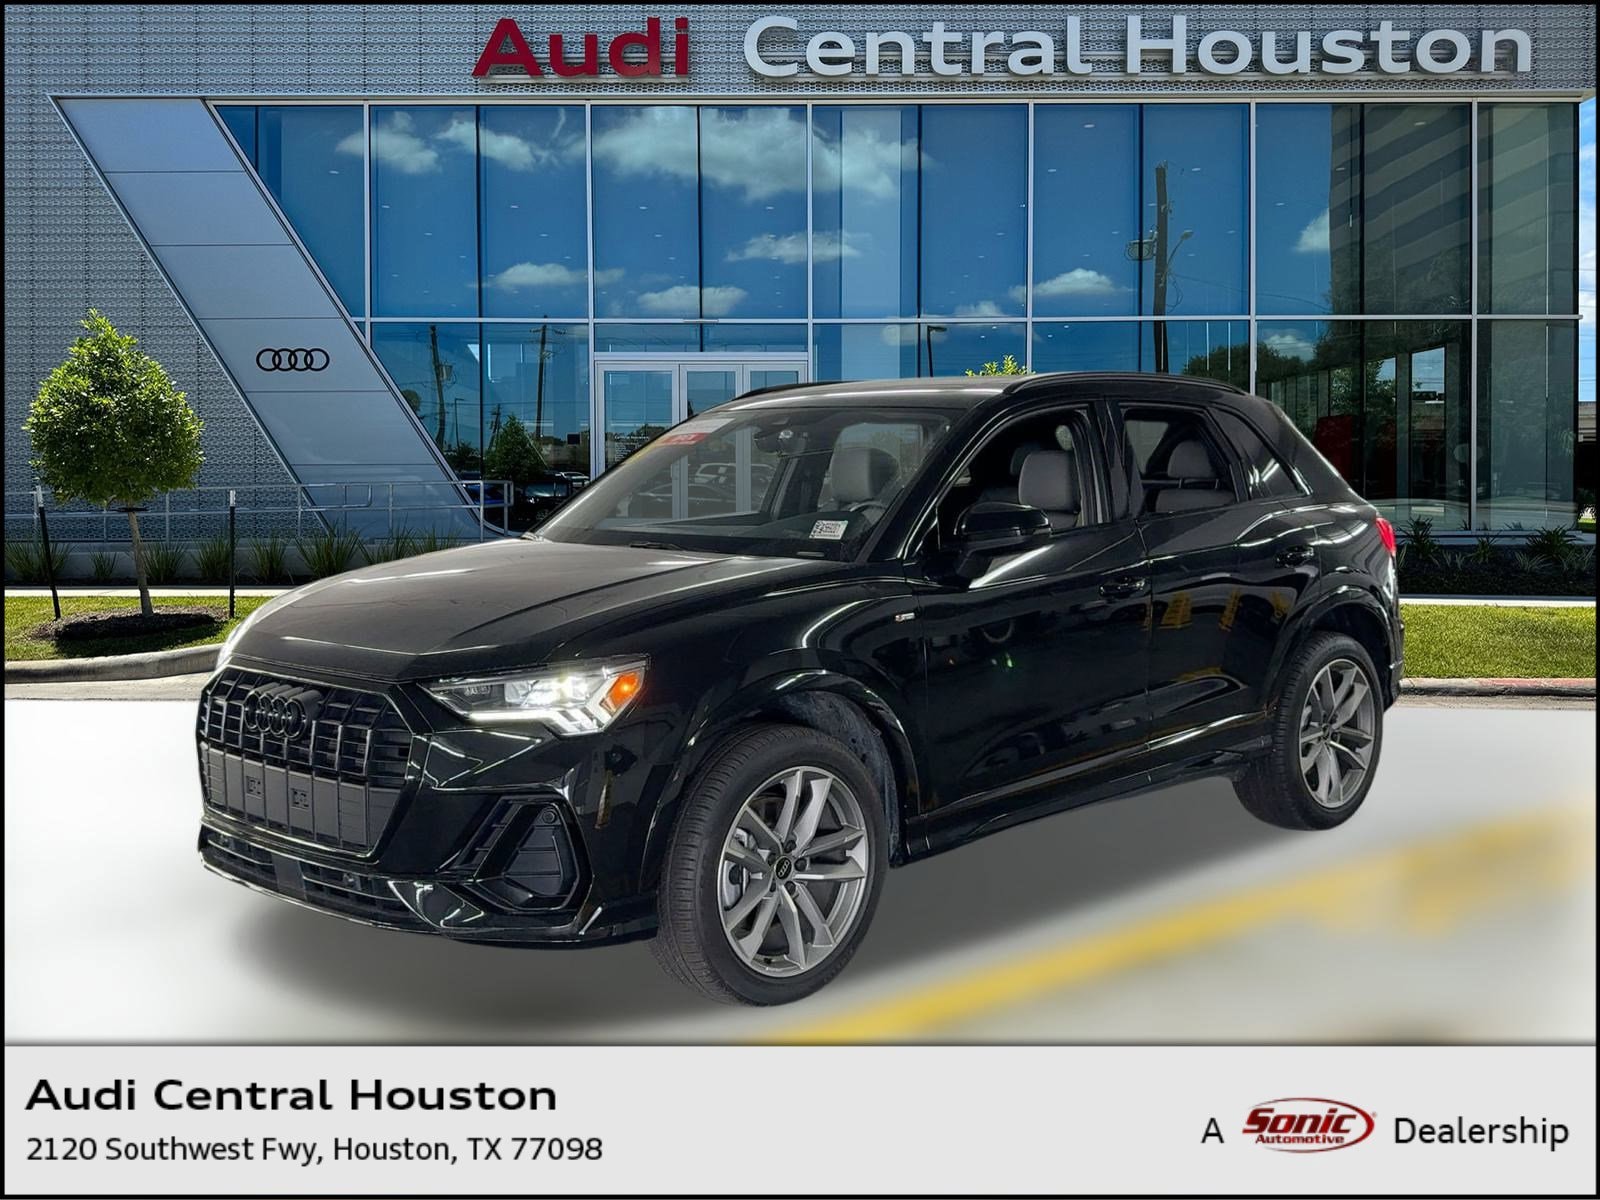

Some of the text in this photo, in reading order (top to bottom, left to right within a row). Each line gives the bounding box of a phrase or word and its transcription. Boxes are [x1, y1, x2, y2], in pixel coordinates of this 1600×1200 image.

[473, 15, 1533, 78] Audi Central Houston
